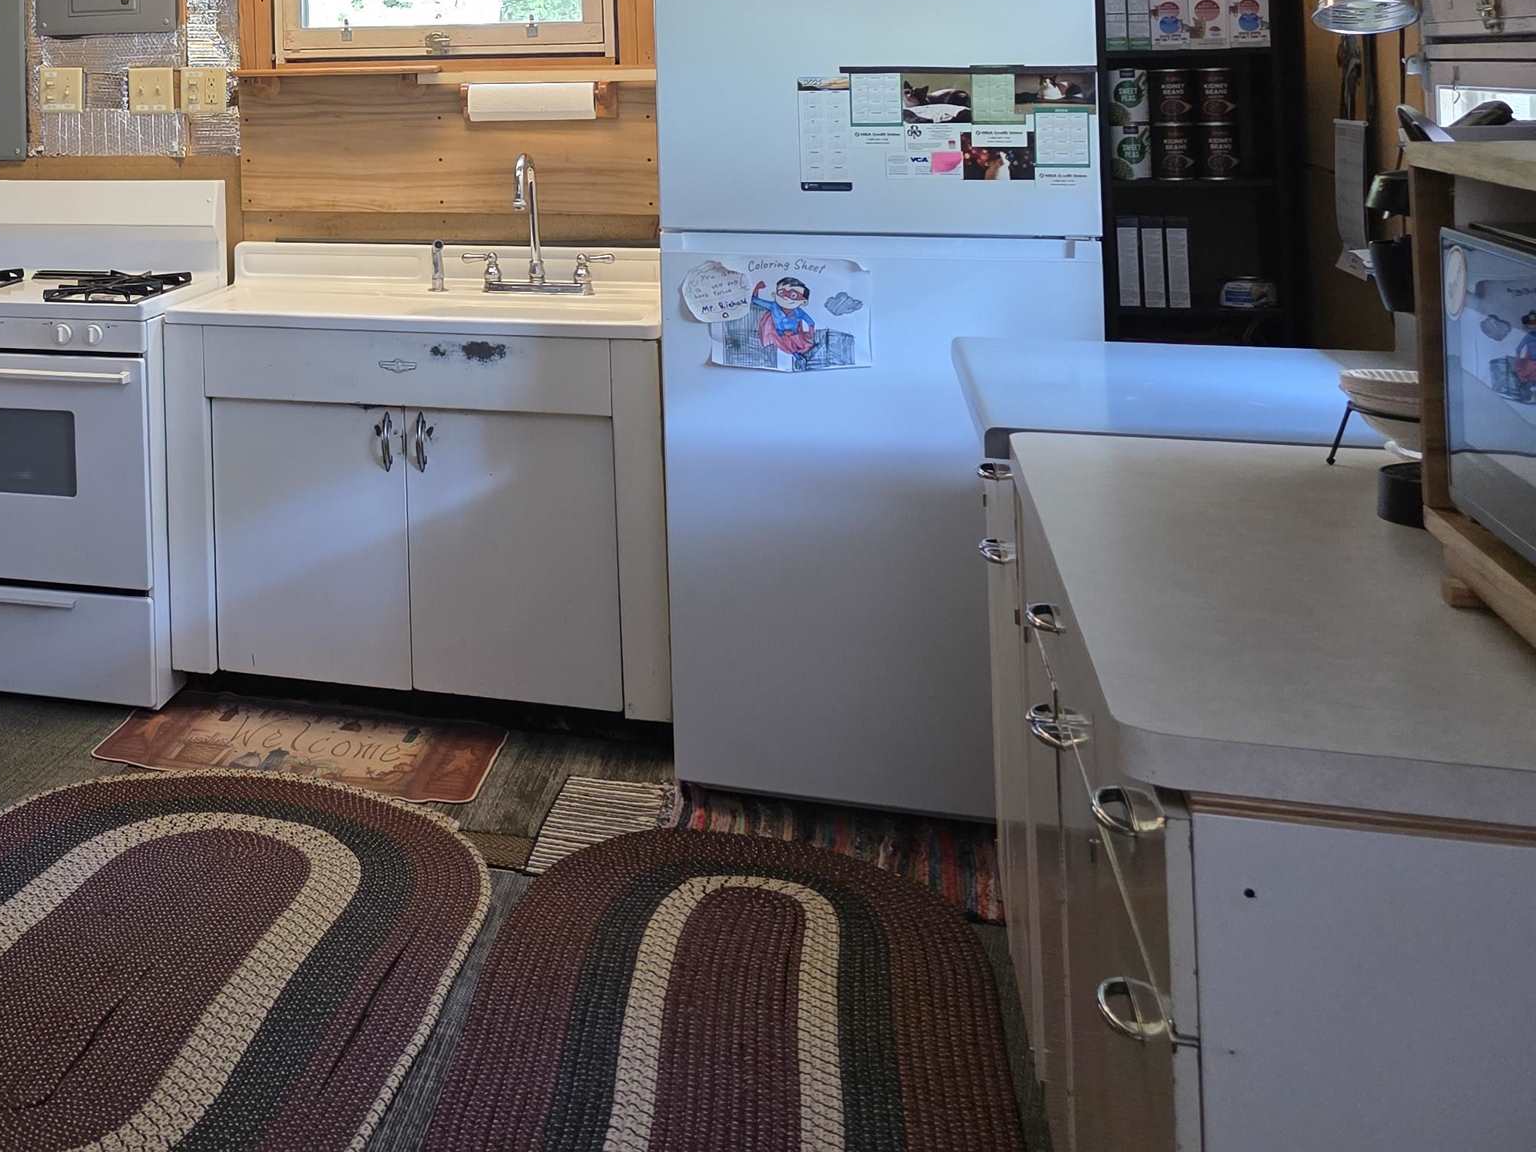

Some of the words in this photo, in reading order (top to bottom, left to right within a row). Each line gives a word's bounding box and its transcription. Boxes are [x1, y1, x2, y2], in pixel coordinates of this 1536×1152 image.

[747, 259, 789, 272] Coloring
[794, 258, 826, 273] Sheet
[230, 715, 402, 763] Welcome
